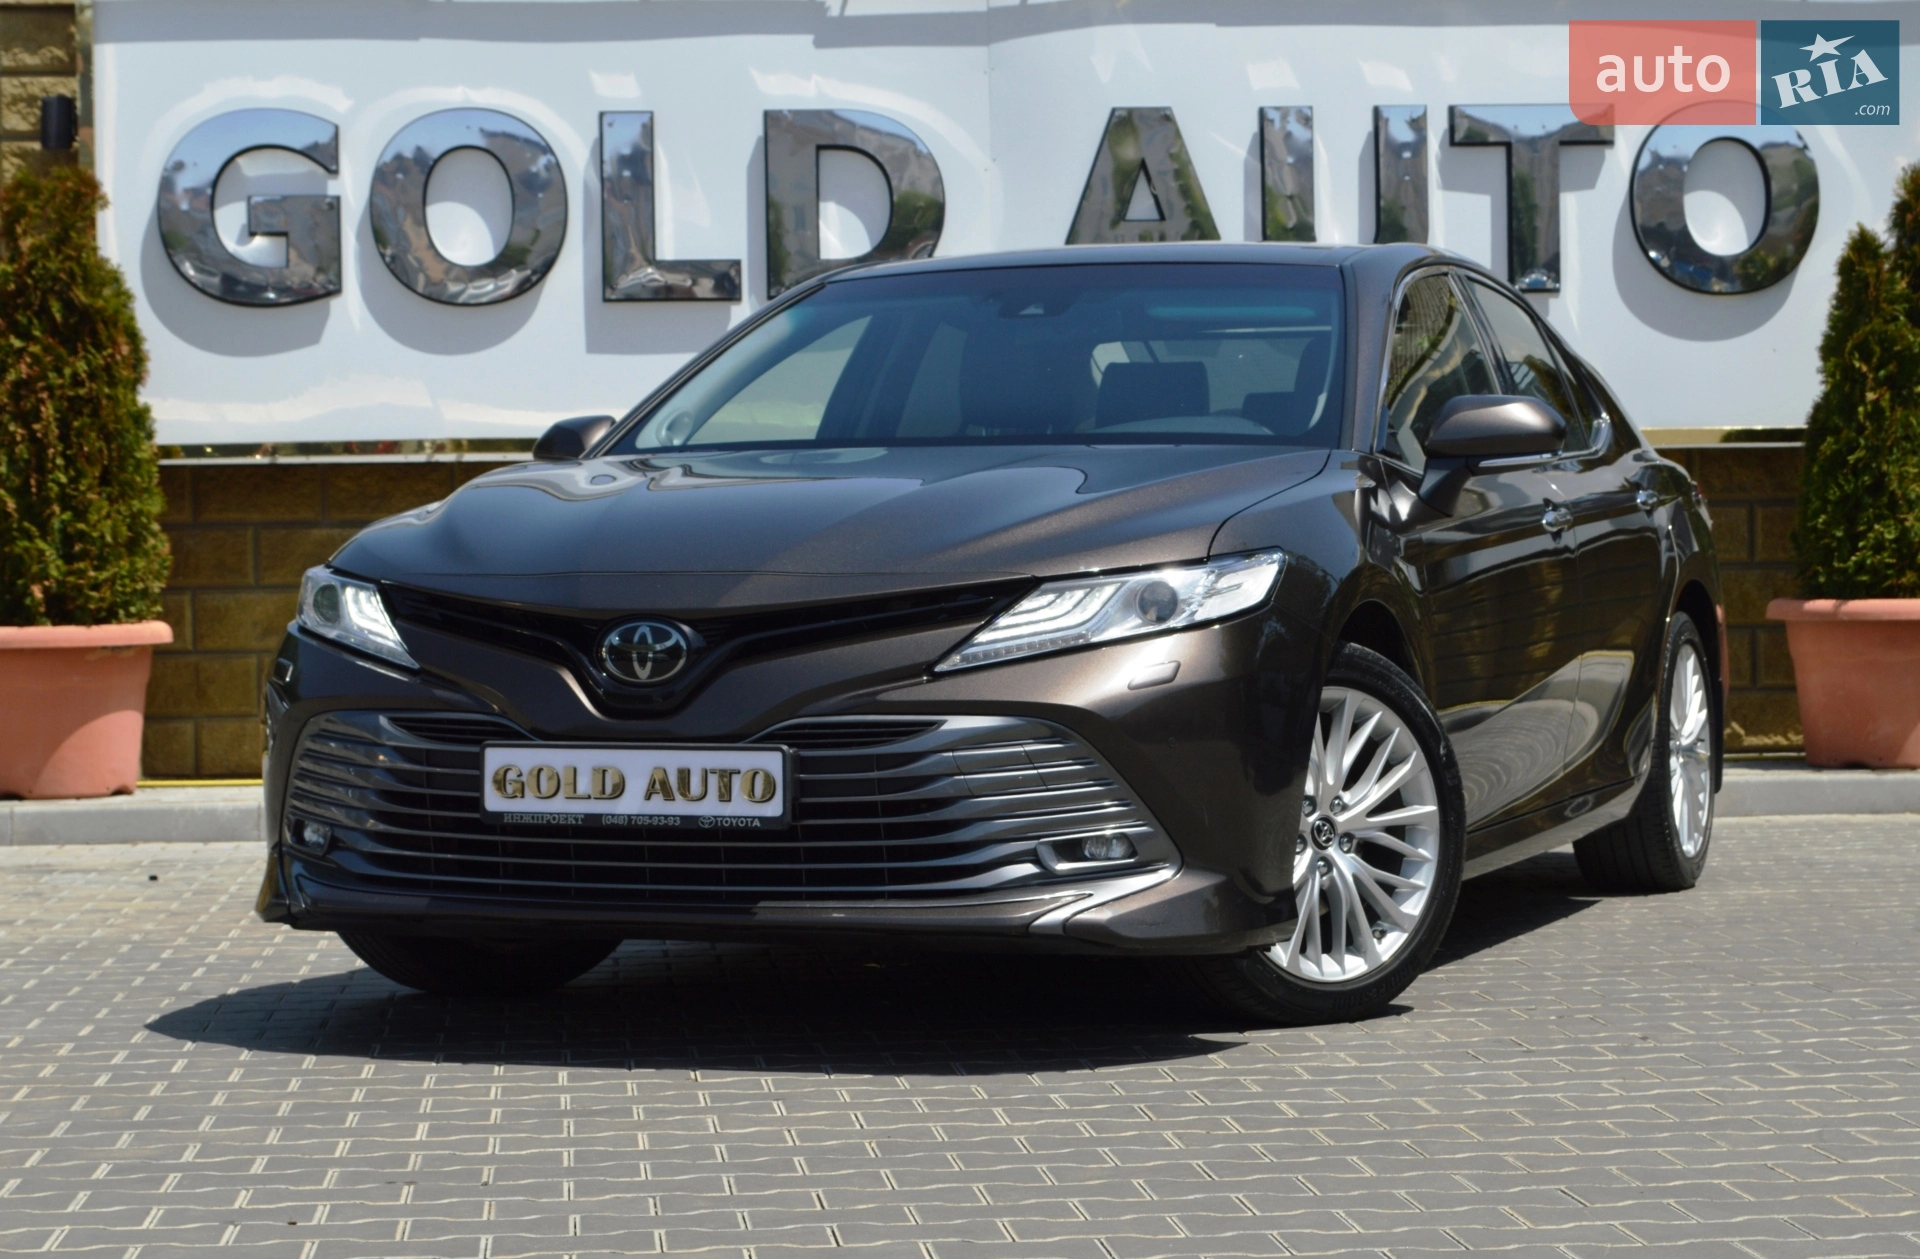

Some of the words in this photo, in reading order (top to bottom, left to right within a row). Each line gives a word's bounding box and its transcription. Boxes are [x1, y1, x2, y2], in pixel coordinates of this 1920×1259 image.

[157, 107, 946, 307] GOLD
[1065, 101, 1822, 295] AUTO
[492, 764, 626, 800] GOLD
[644, 767, 777, 803] AUTO
[503, 813, 584, 825] ИНЖПРОЕКТ
[601, 815, 628, 826] (048)
[631, 816, 681, 826] 705-93-93
[716, 817, 761, 828] TOYOTA
